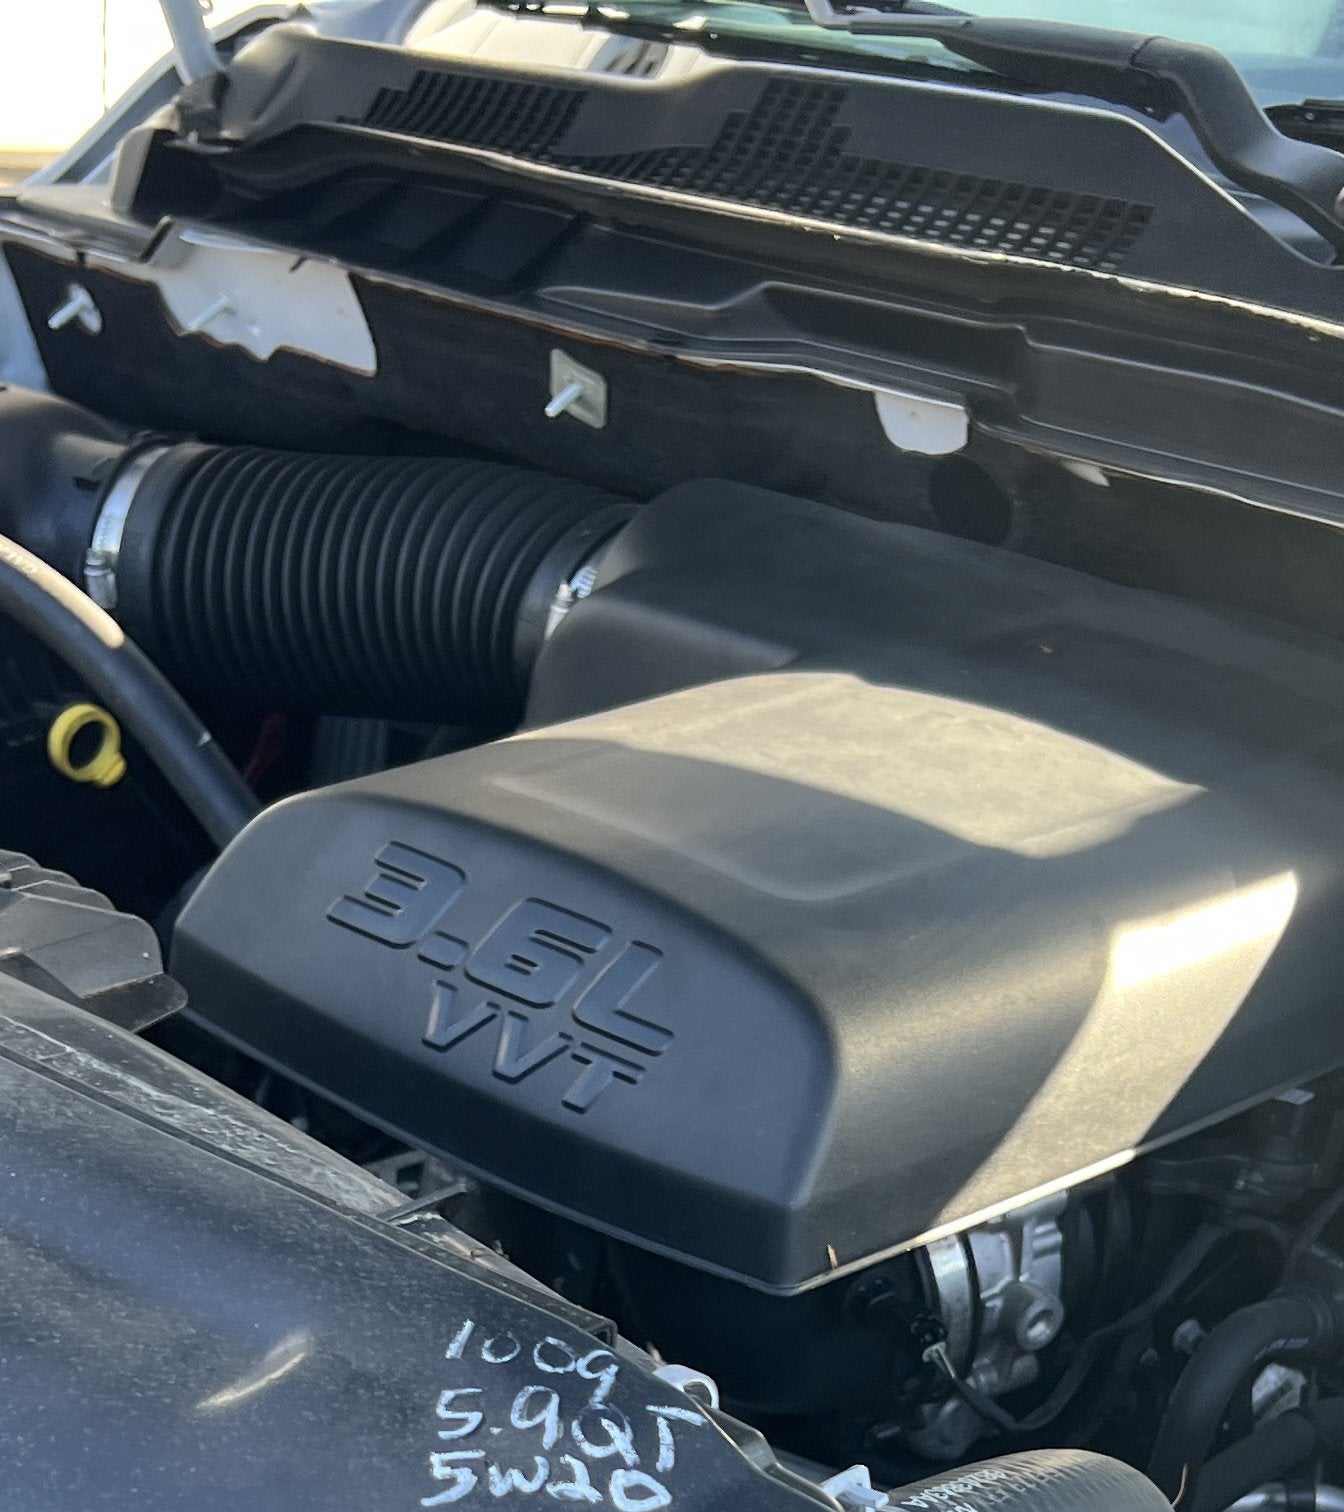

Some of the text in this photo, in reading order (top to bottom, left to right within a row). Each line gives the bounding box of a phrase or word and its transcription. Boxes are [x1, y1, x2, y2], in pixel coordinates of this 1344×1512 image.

[326, 840, 675, 1056] 3.6L
[422, 980, 647, 1114] VVT
[445, 1318, 619, 1409] 1009
